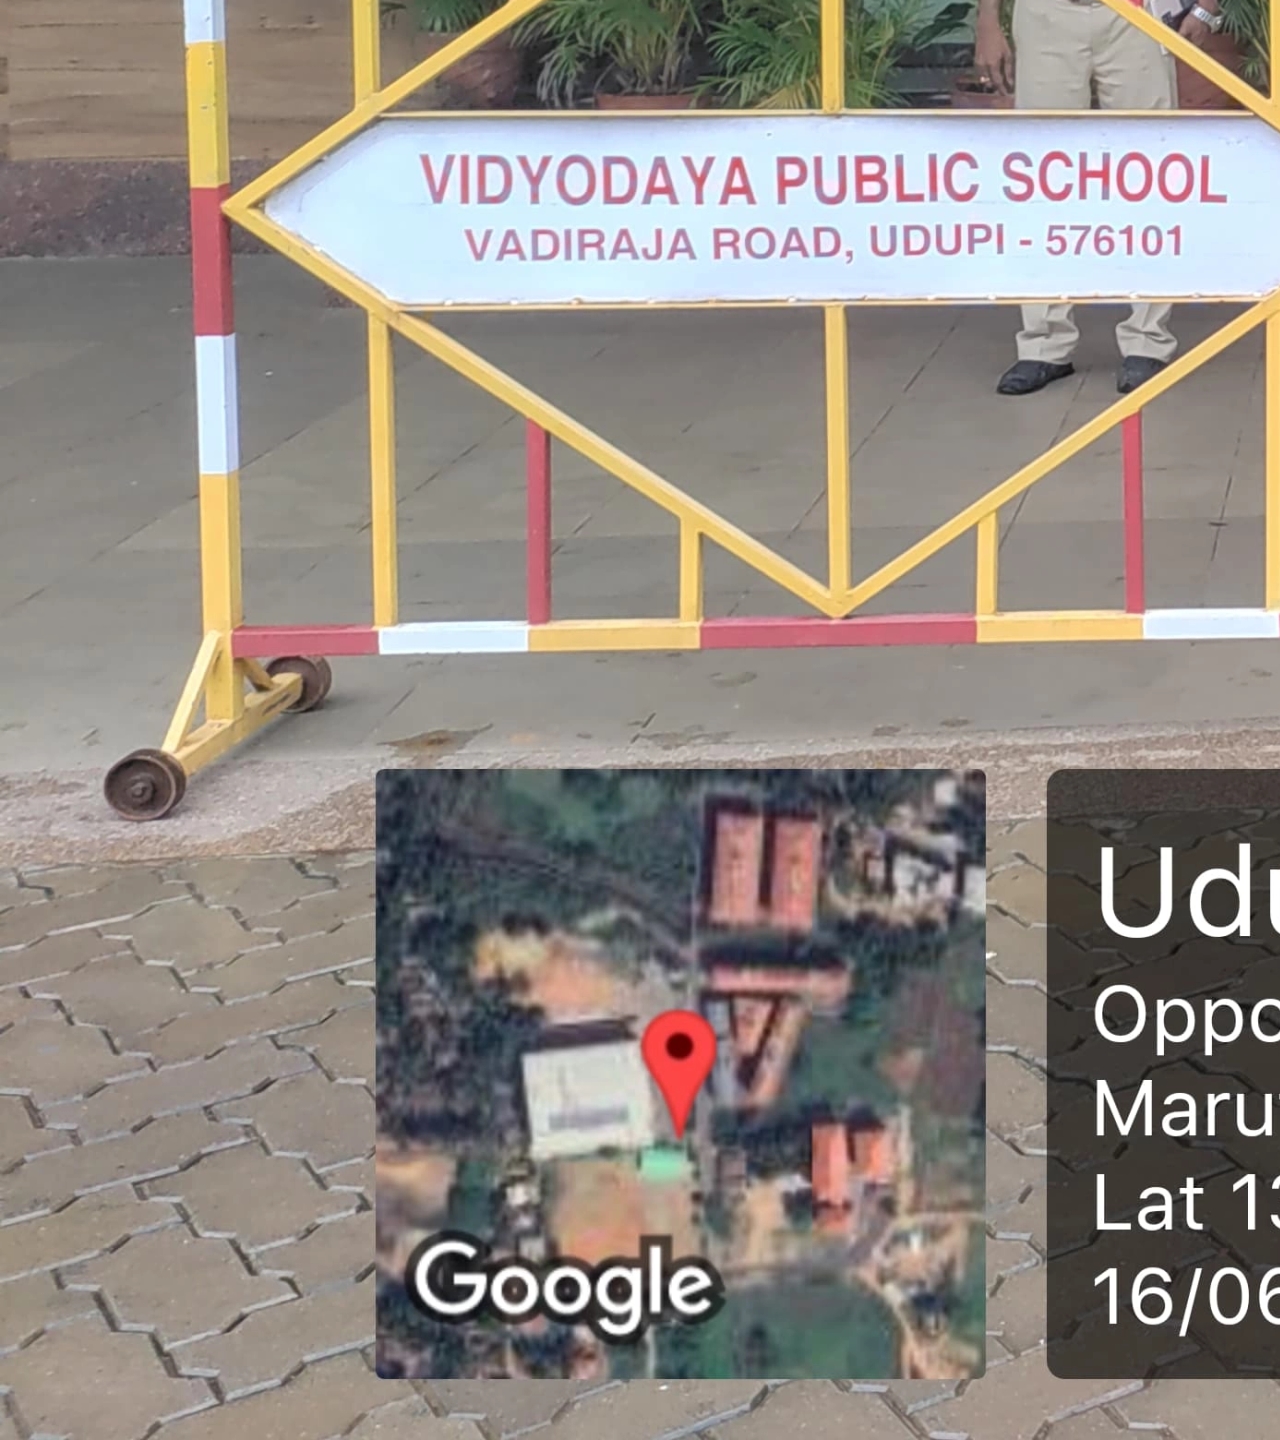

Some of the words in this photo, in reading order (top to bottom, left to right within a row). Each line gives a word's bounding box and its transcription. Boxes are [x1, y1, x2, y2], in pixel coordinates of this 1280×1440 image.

[420, 154, 756, 206] VIDYODAYA
[777, 151, 980, 205] PUBLIC
[1002, 151, 1227, 203] SCHOOL
[465, 227, 697, 262] VADIRAJA
[713, 224, 854, 264] ROAD,
[870, 222, 1004, 257] UDUPI
[1045, 223, 1182, 257] 576101
